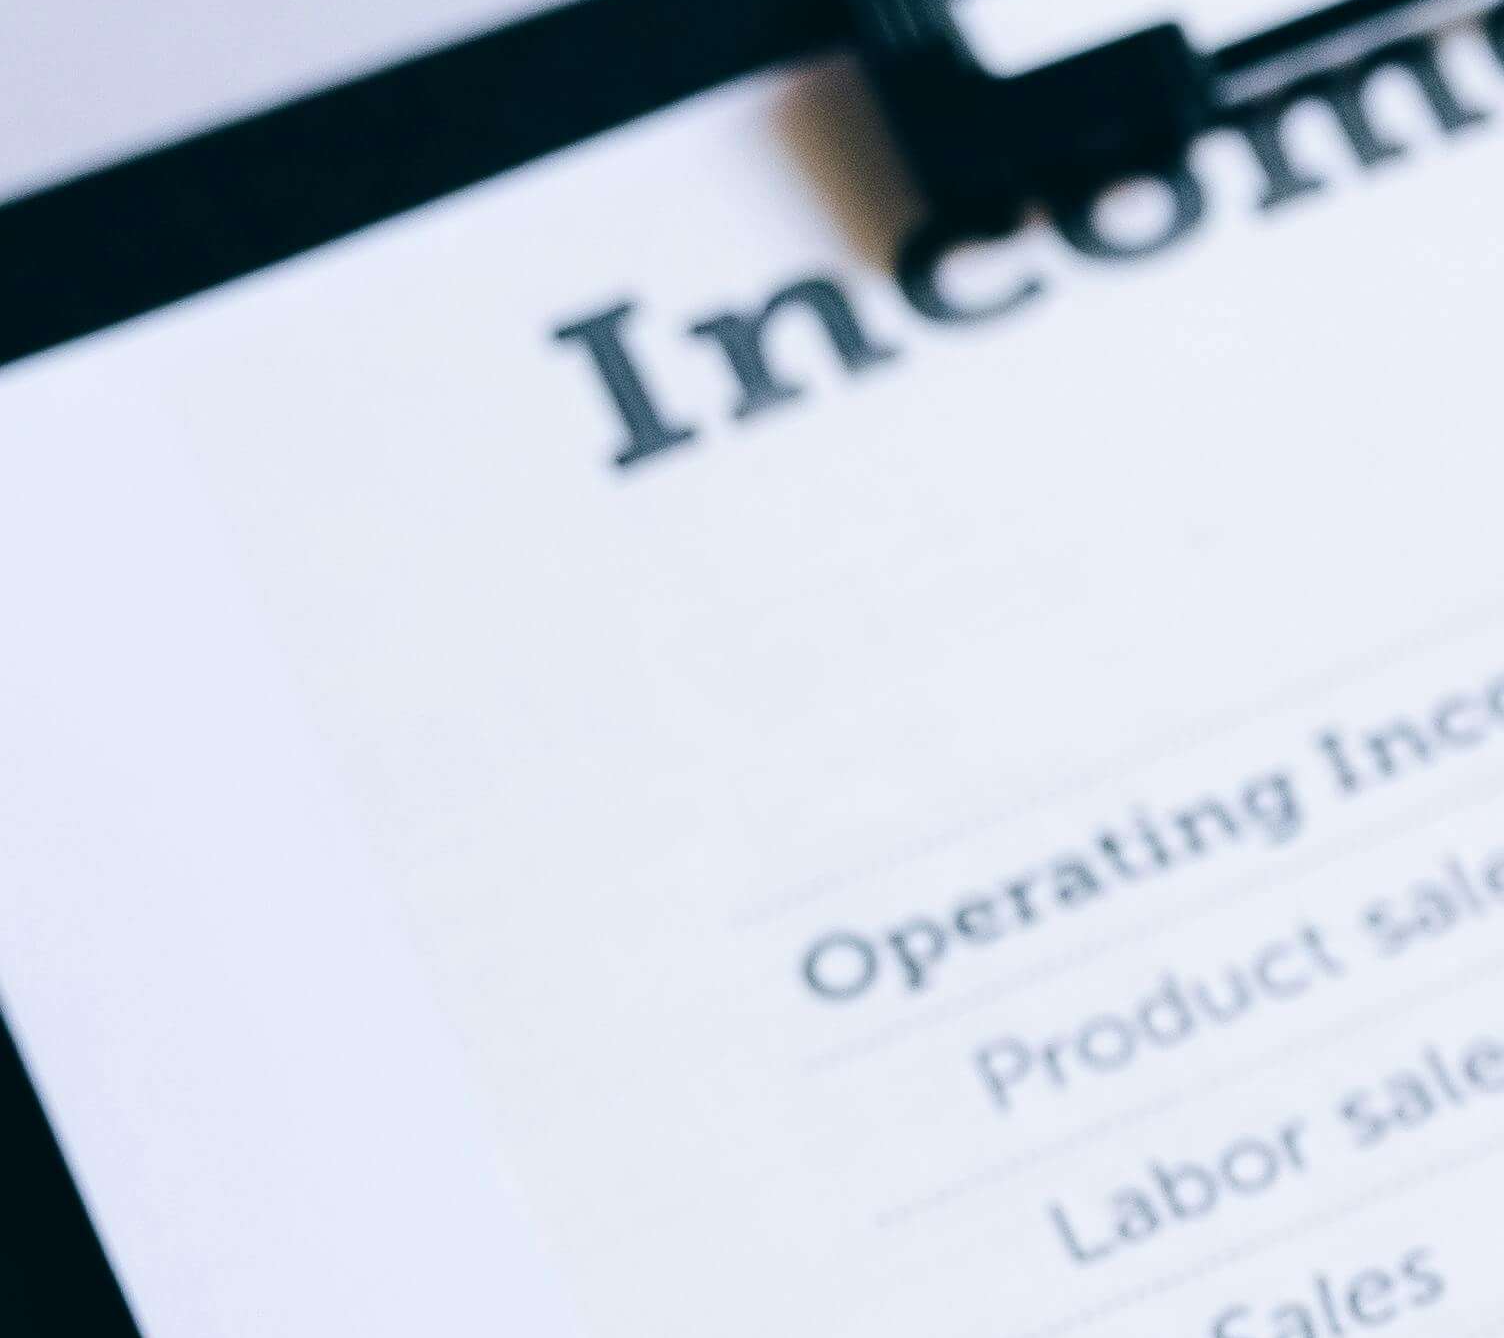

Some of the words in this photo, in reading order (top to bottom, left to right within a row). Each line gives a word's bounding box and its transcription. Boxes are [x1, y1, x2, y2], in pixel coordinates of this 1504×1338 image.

[795, 769, 1305, 1006] Operating
[968, 921, 1345, 1115] Product
[1046, 1118, 1308, 1268] Labor
